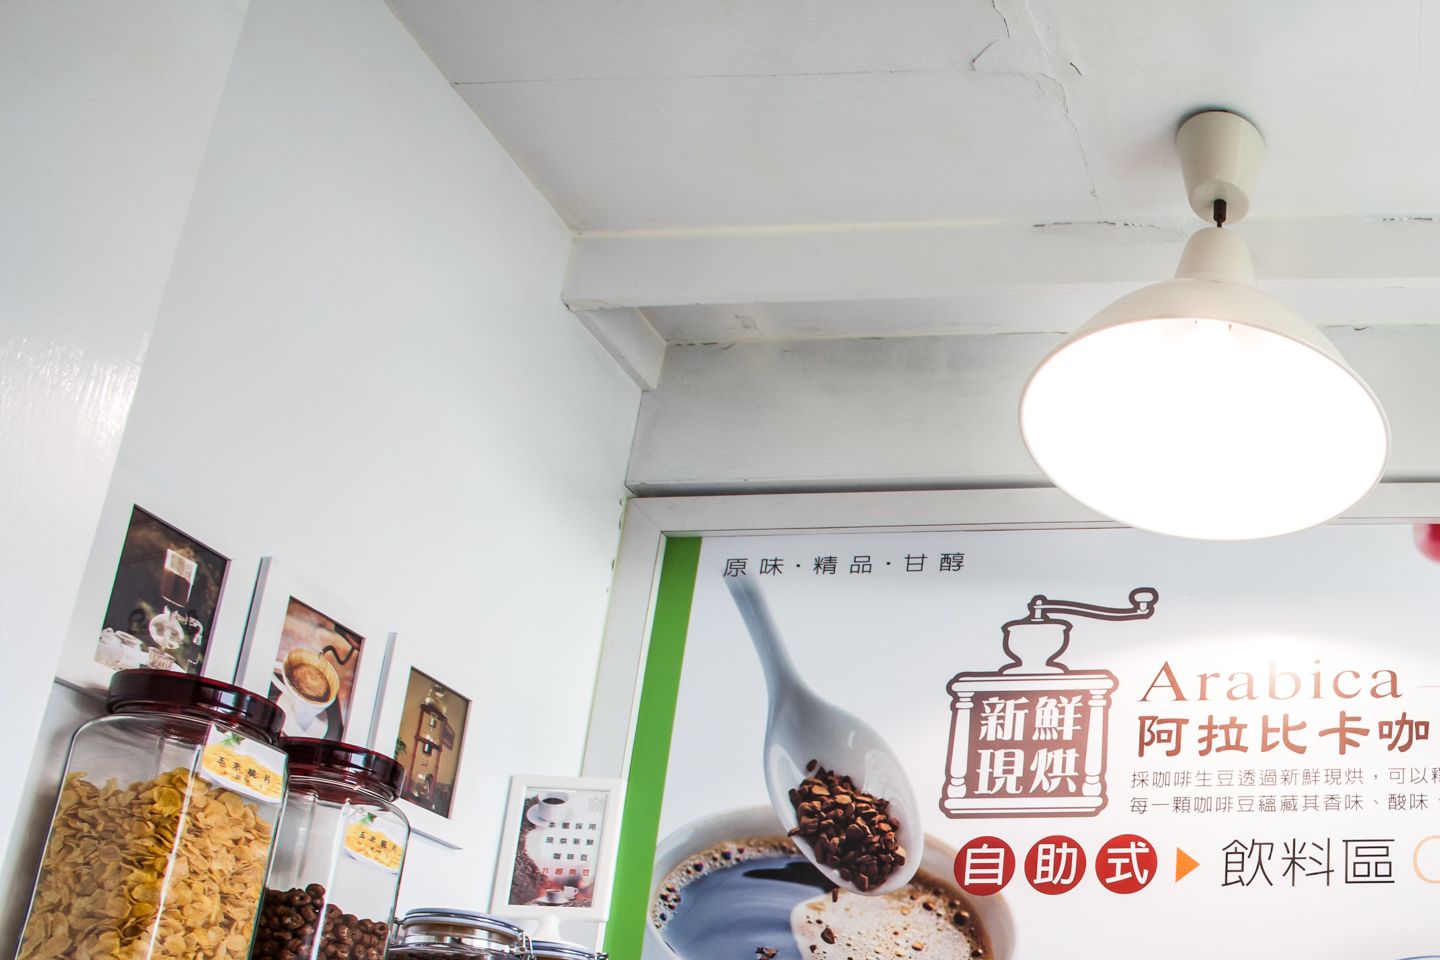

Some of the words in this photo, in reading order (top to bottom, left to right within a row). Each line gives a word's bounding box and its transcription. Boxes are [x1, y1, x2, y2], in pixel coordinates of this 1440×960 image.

[1138, 658, 1404, 703] Arabica
[979, 694, 1084, 743] 新鮮
[974, 747, 1081, 796] 現烘
[962, 841, 1151, 887] 自助式
[1220, 836, 1397, 889] 飲料區
